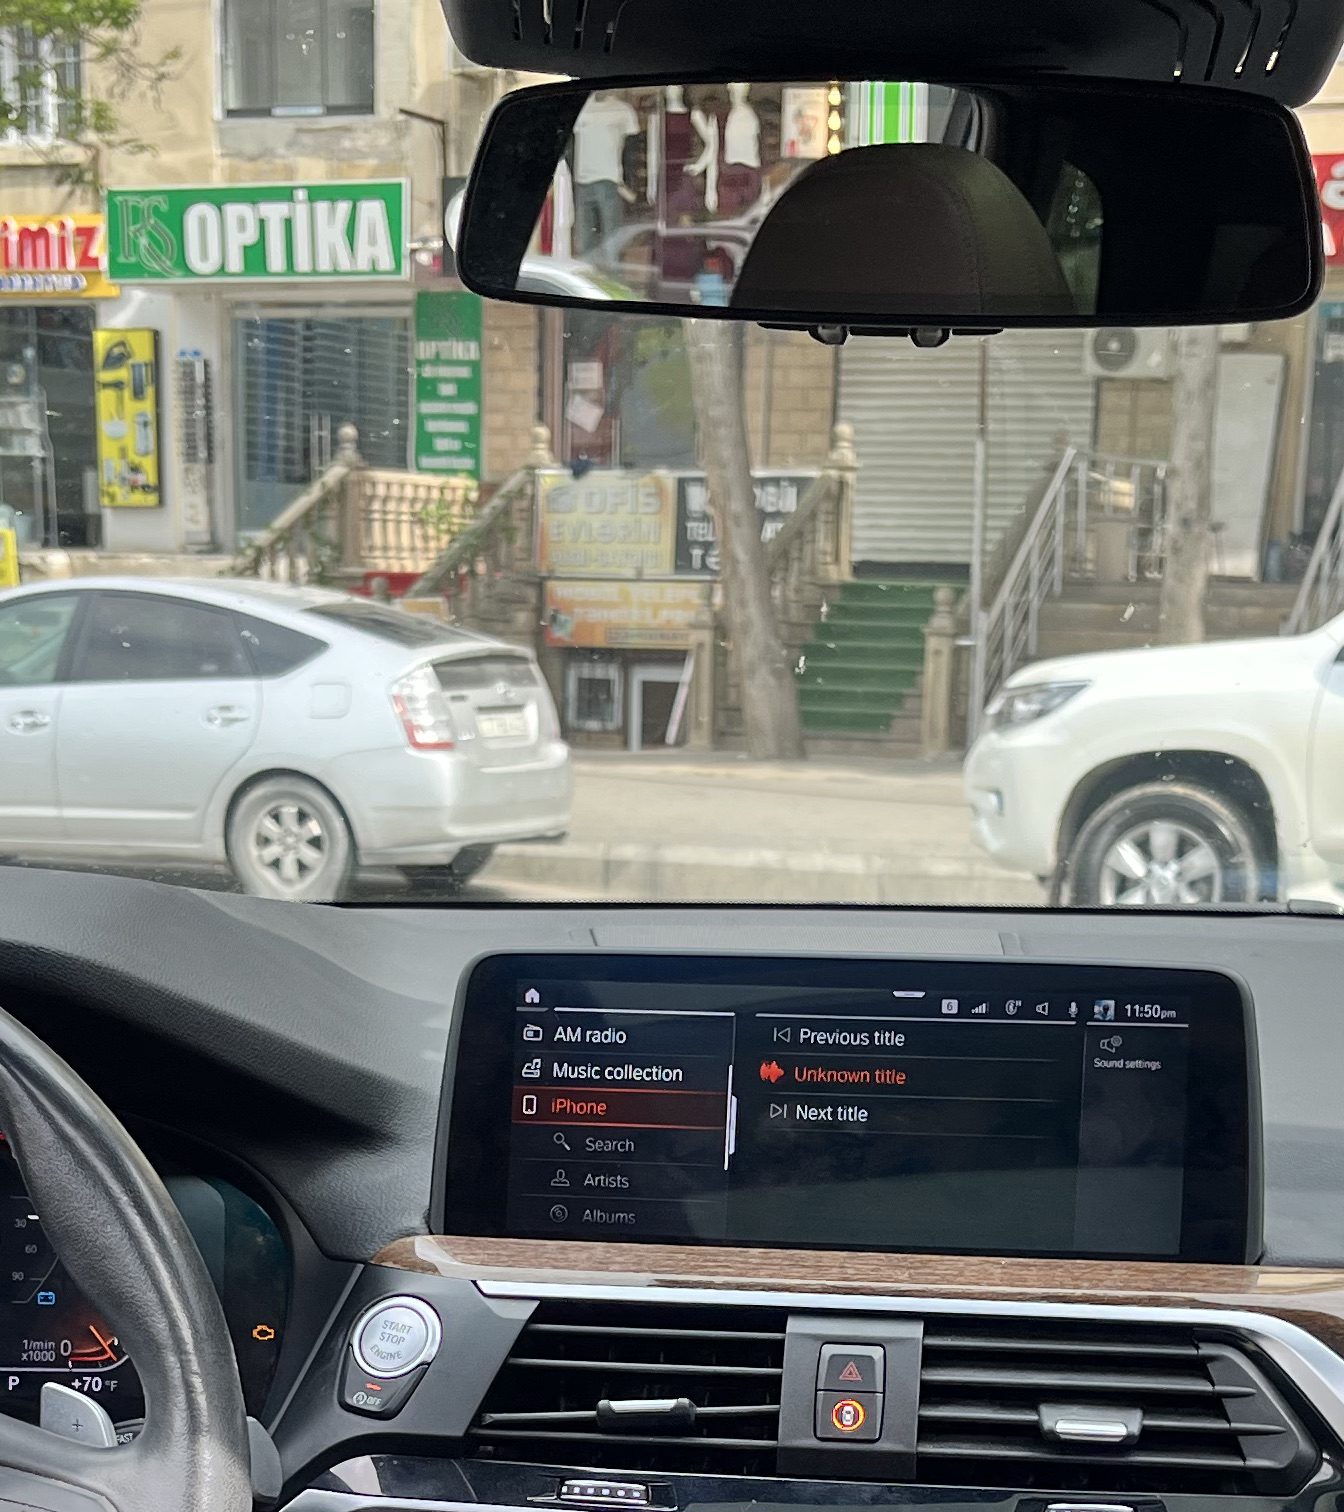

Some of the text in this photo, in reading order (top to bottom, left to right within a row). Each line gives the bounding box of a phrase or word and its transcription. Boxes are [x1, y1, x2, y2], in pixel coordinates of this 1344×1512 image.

[554, 1027, 627, 1044] AM radio
[799, 1028, 906, 1046] Previous title
[1094, 1057, 1123, 1069] Sound
[553, 1063, 683, 1083] Music collection
[794, 1067, 907, 1085] Unknown title
[551, 1099, 607, 1115] iPhone
[796, 1105, 869, 1122] Next title
[585, 1137, 635, 1152] Search
[584, 1174, 630, 1188] Artists
[583, 1209, 637, 1224] Albums
[382, 1319, 413, 1334] START
[22, 1340, 56, 1350] 1/min
[379, 1332, 405, 1345] STOP
[60, 1339, 72, 1357] 0
[21, 1351, 56, 1362] x1000
[8, 1376, 20, 1391] P
[71, 1376, 103, 1392] +70
